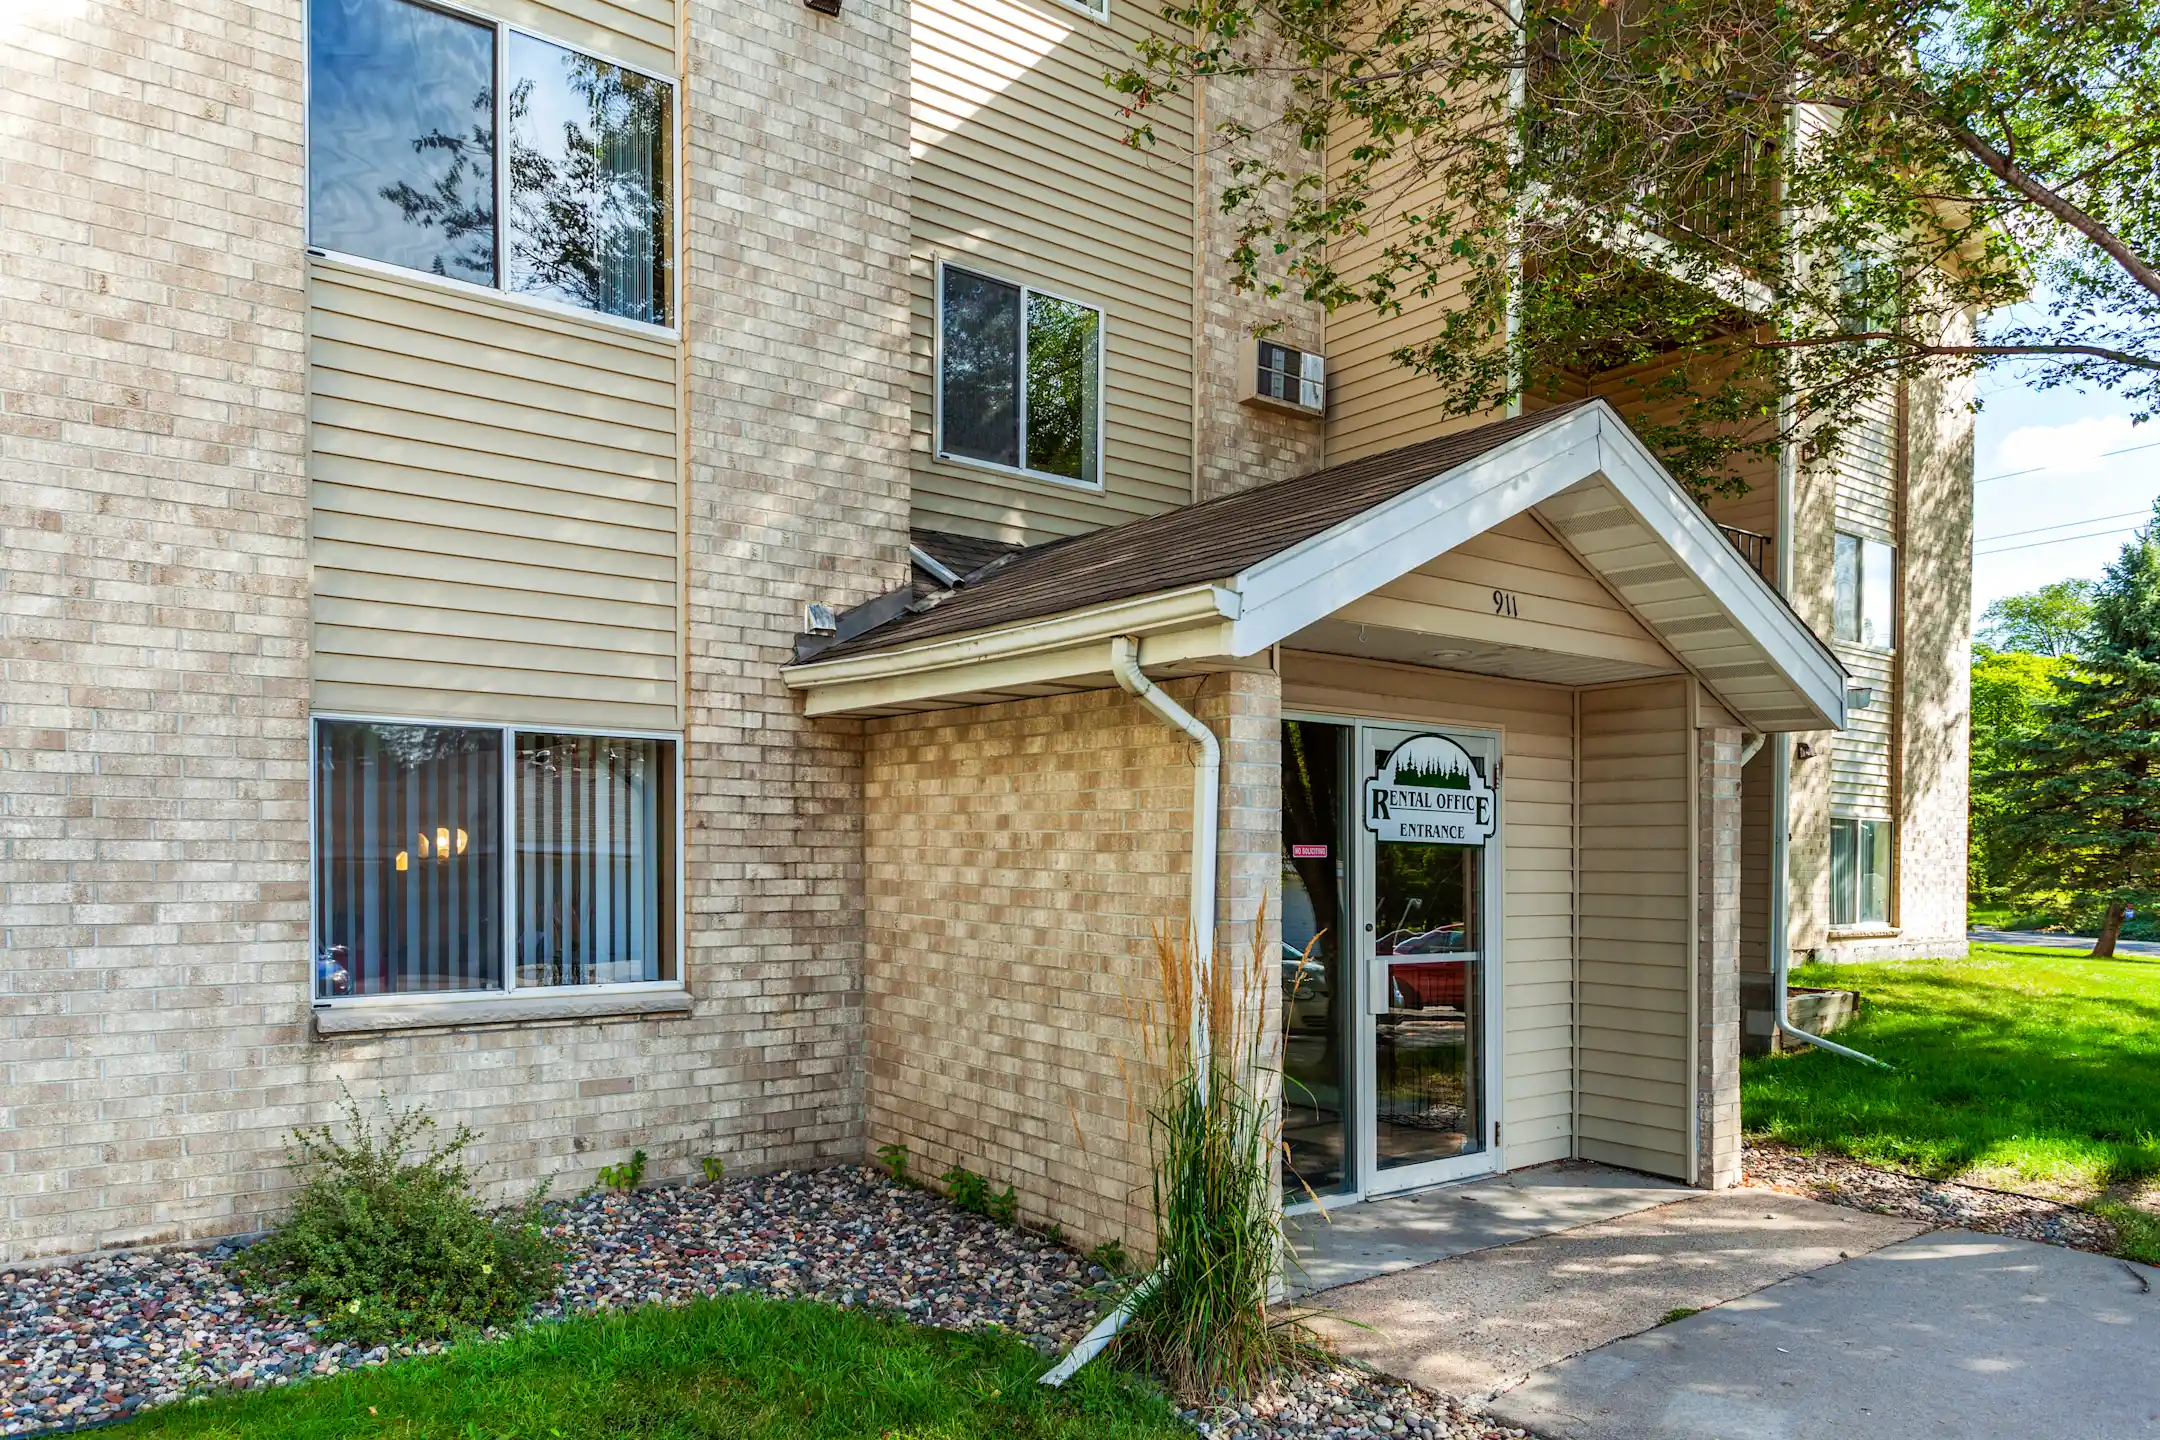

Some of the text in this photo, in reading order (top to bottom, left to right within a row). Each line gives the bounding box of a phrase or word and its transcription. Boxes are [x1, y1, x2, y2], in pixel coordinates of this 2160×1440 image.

[1493, 590, 1518, 617] 911
[1371, 788, 1490, 826] RENTAL OFFICE
[1400, 823, 1465, 839] ENTRANCE
[1294, 847, 1302, 855] NO
